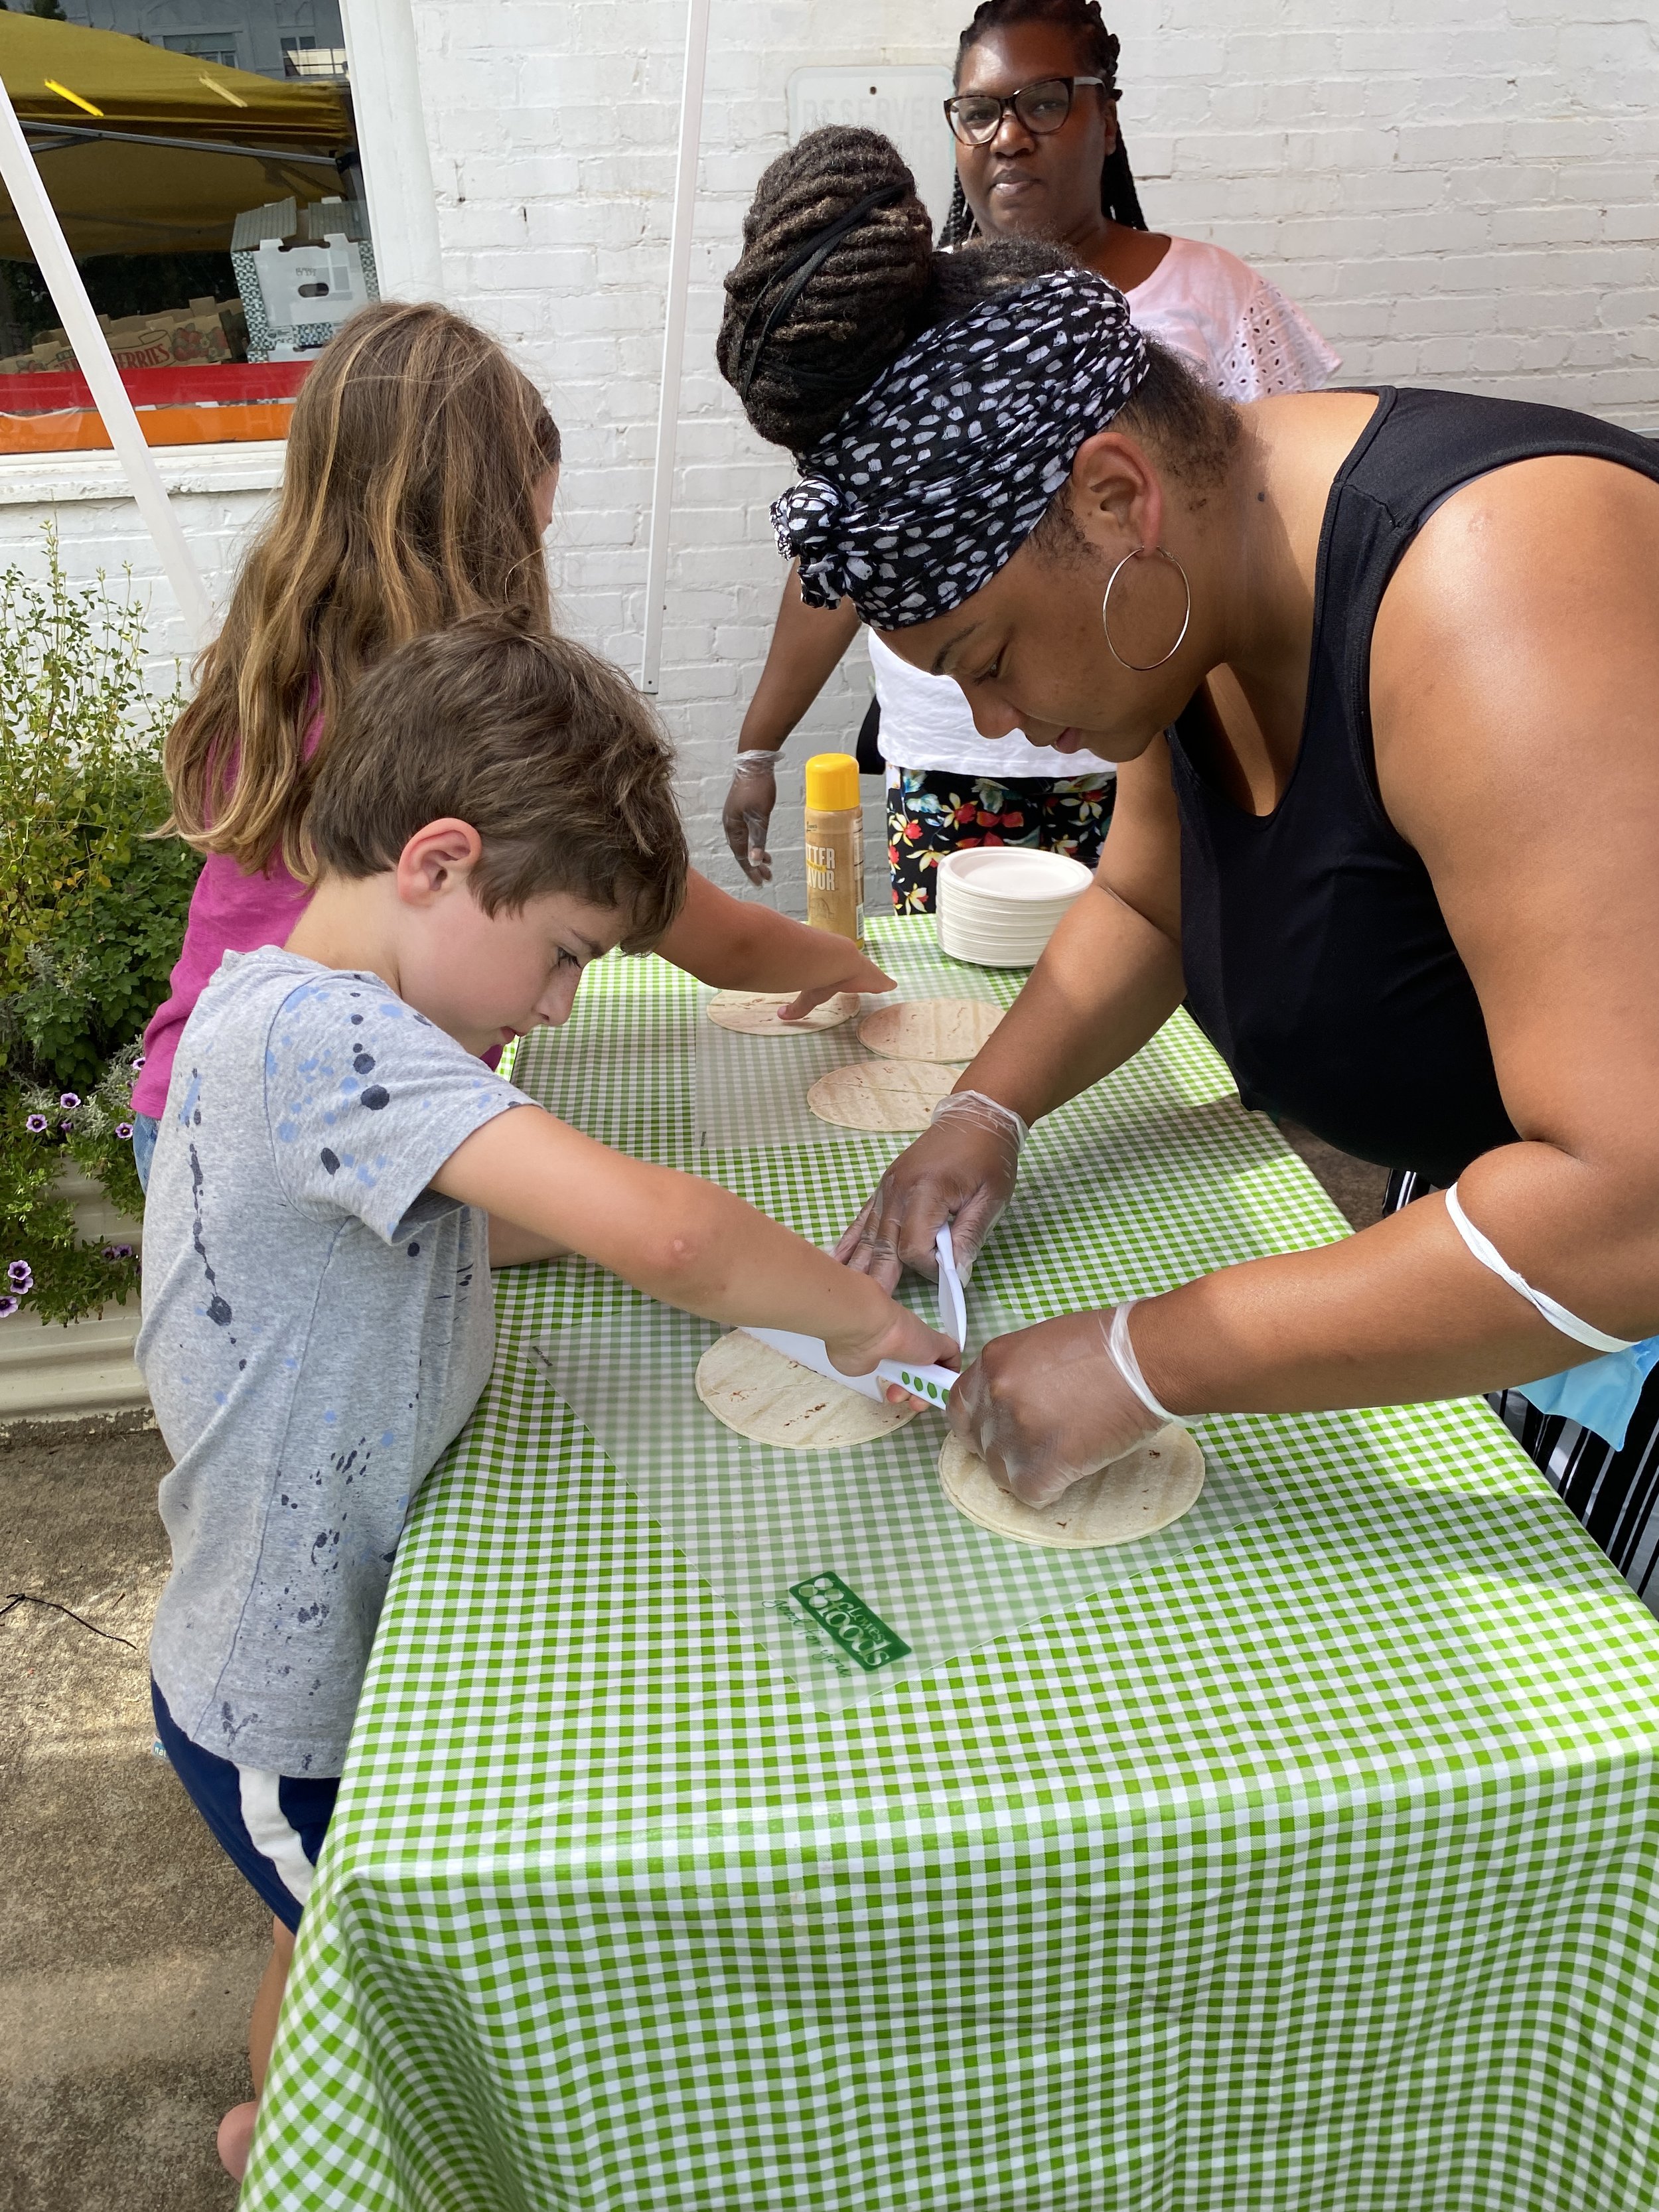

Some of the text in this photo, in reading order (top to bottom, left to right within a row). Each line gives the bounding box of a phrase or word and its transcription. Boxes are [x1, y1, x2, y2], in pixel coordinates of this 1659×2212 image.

[806, 868, 835, 891] AVOR
[761, 1599, 813, 1626] good
[798, 1629, 824, 1647] for
[817, 1601, 892, 1666] foods
[849, 1607, 885, 1643] Lowes
